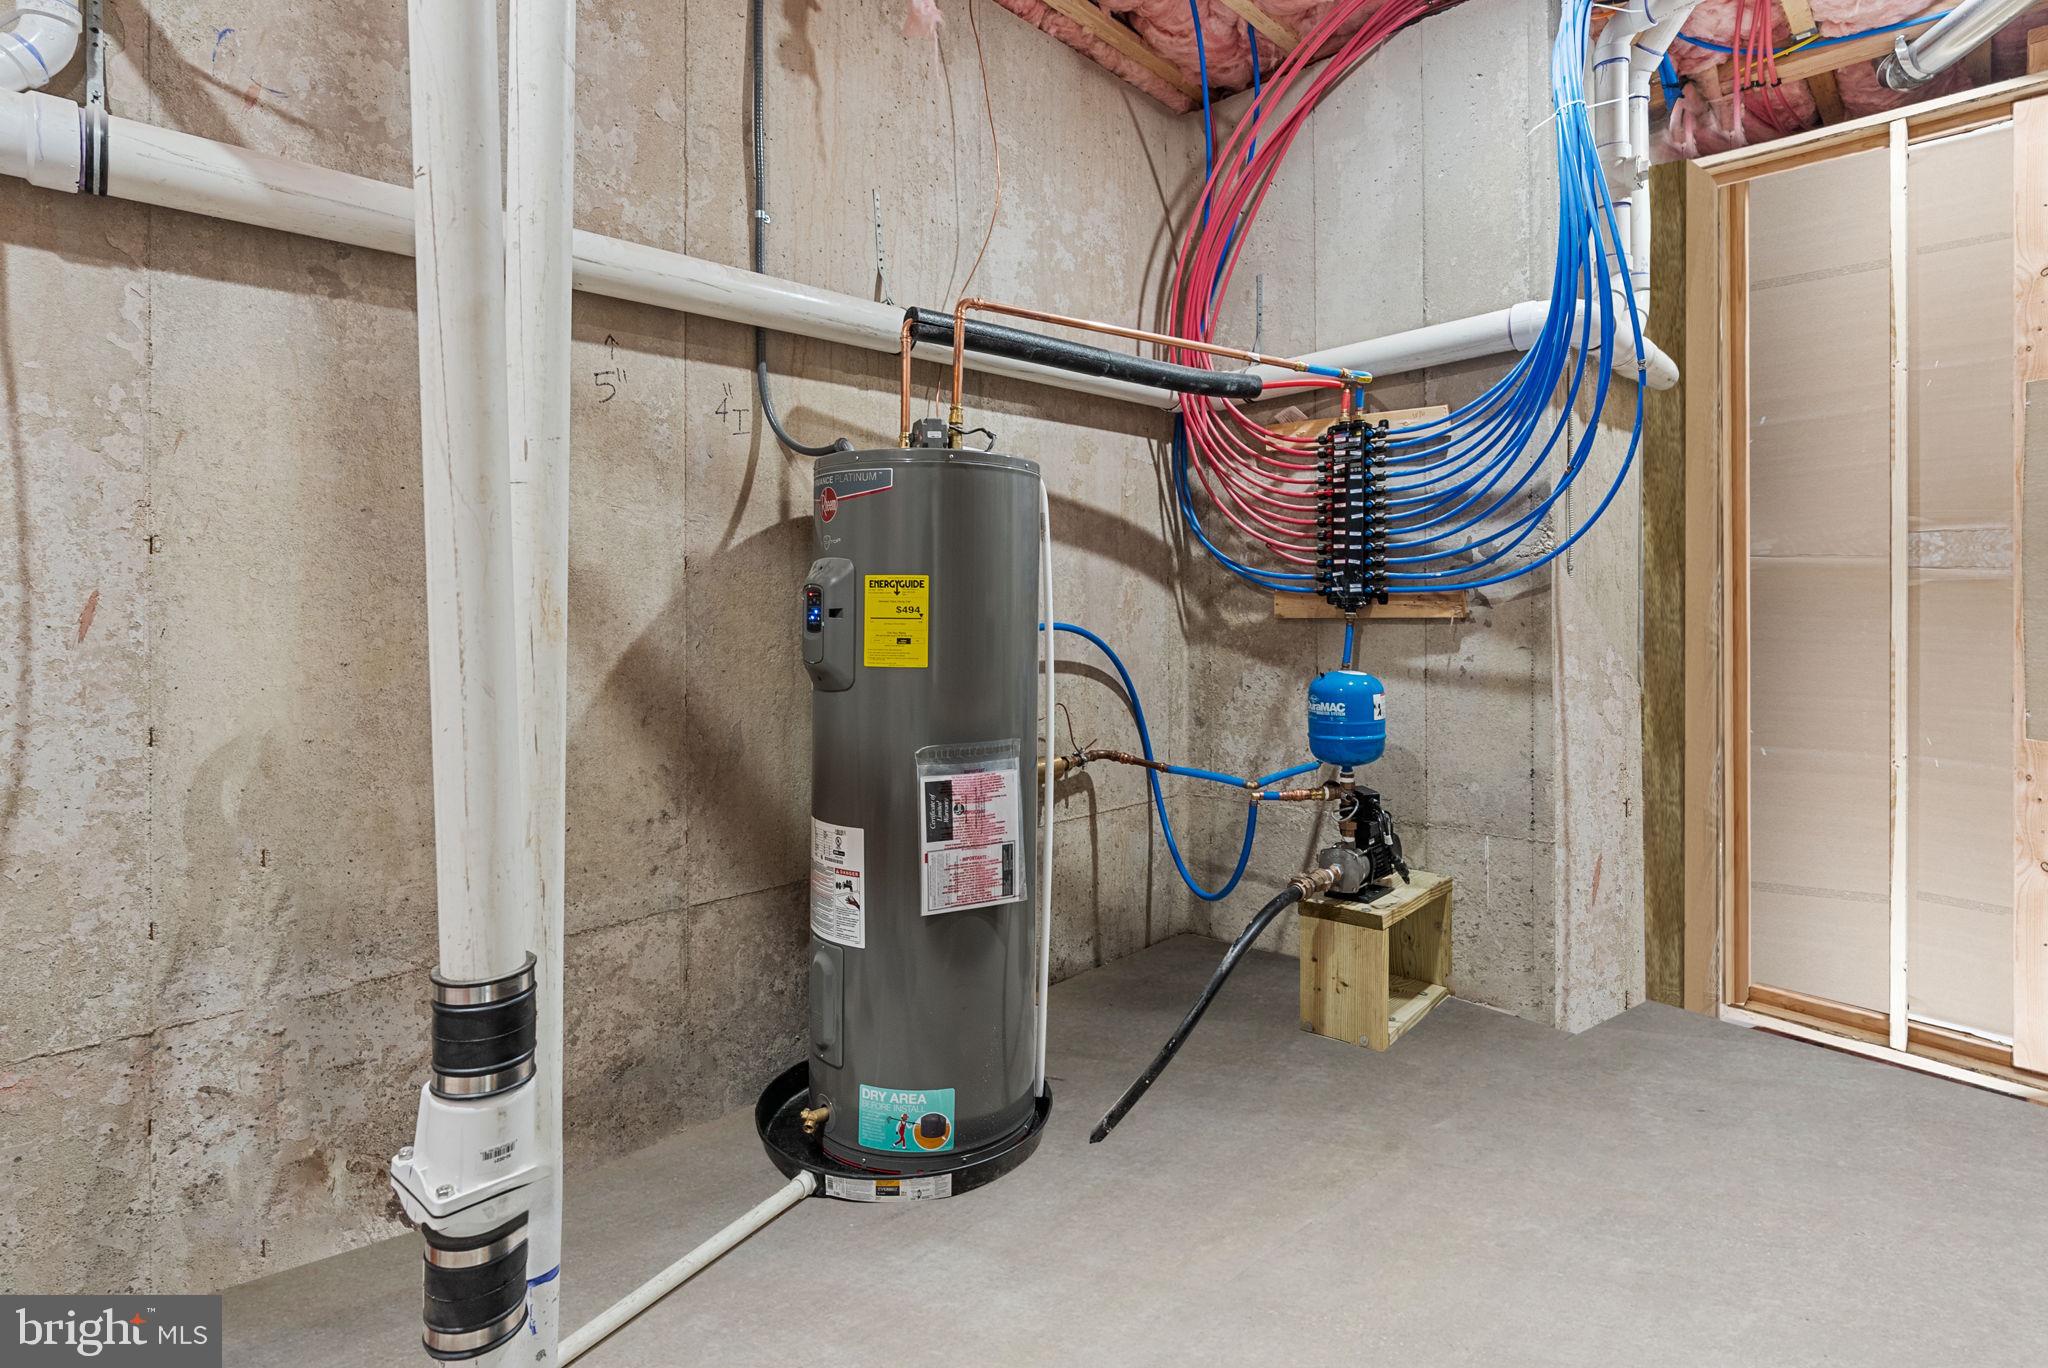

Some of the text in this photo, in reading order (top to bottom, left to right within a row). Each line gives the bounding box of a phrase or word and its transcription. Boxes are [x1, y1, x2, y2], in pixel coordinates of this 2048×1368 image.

[834, 471, 877, 484] PLATINUM
[862, 1087, 927, 1104] DRY AREA
[862, 1100, 891, 1112] BEFORE
